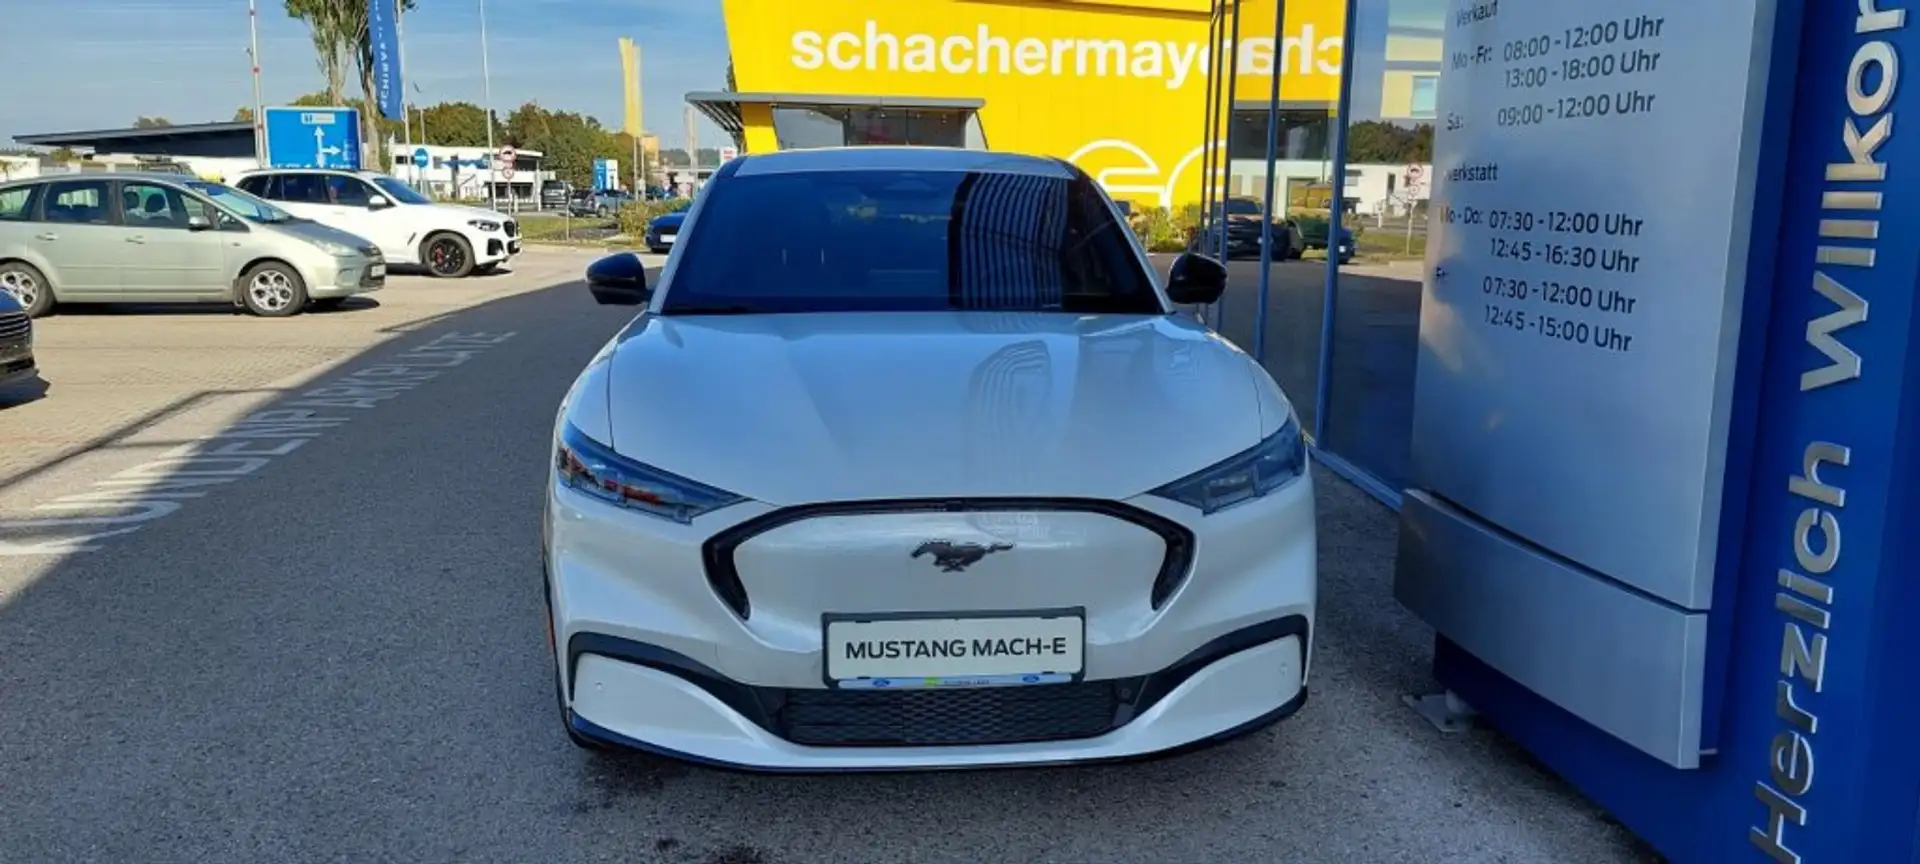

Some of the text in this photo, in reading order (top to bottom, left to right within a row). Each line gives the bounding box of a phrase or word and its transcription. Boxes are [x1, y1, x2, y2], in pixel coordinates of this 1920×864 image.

[1456, 0, 1498, 28] Verkauf
[1504, 35, 1550, 62] 08:00
[1565, 21, 1618, 49] 12:00
[1624, 15, 1664, 40] Uhr
[1505, 66, 1547, 89] 13:00
[1562, 54, 1614, 81] 18:00
[1620, 49, 1660, 74] Uhr
[1498, 104, 1542, 127] 09:00
[1557, 93, 1610, 119] 12:00
[1616, 90, 1655, 113] Uhr
[1489, 210, 1533, 231] 07:30
[1548, 212, 1599, 234] 12:00
[1604, 213, 1644, 237] Uhr
[1491, 238, 1531, 261] 12:45
[1545, 244, 1596, 269] 16:30
[1601, 249, 1640, 273] Uhr
[1483, 276, 1527, 300] 07:30
[1542, 282, 1592, 307] 12:00
[1598, 290, 1636, 314] Uhr
[1485, 305, 1525, 331] 12:45
[1539, 316, 1589, 344] 15:00
[1594, 326, 1632, 351] Uhr
[845, 637, 1066, 659] MUSTANG MACH-E
[1750, 441, 1850, 864] Herzlich
